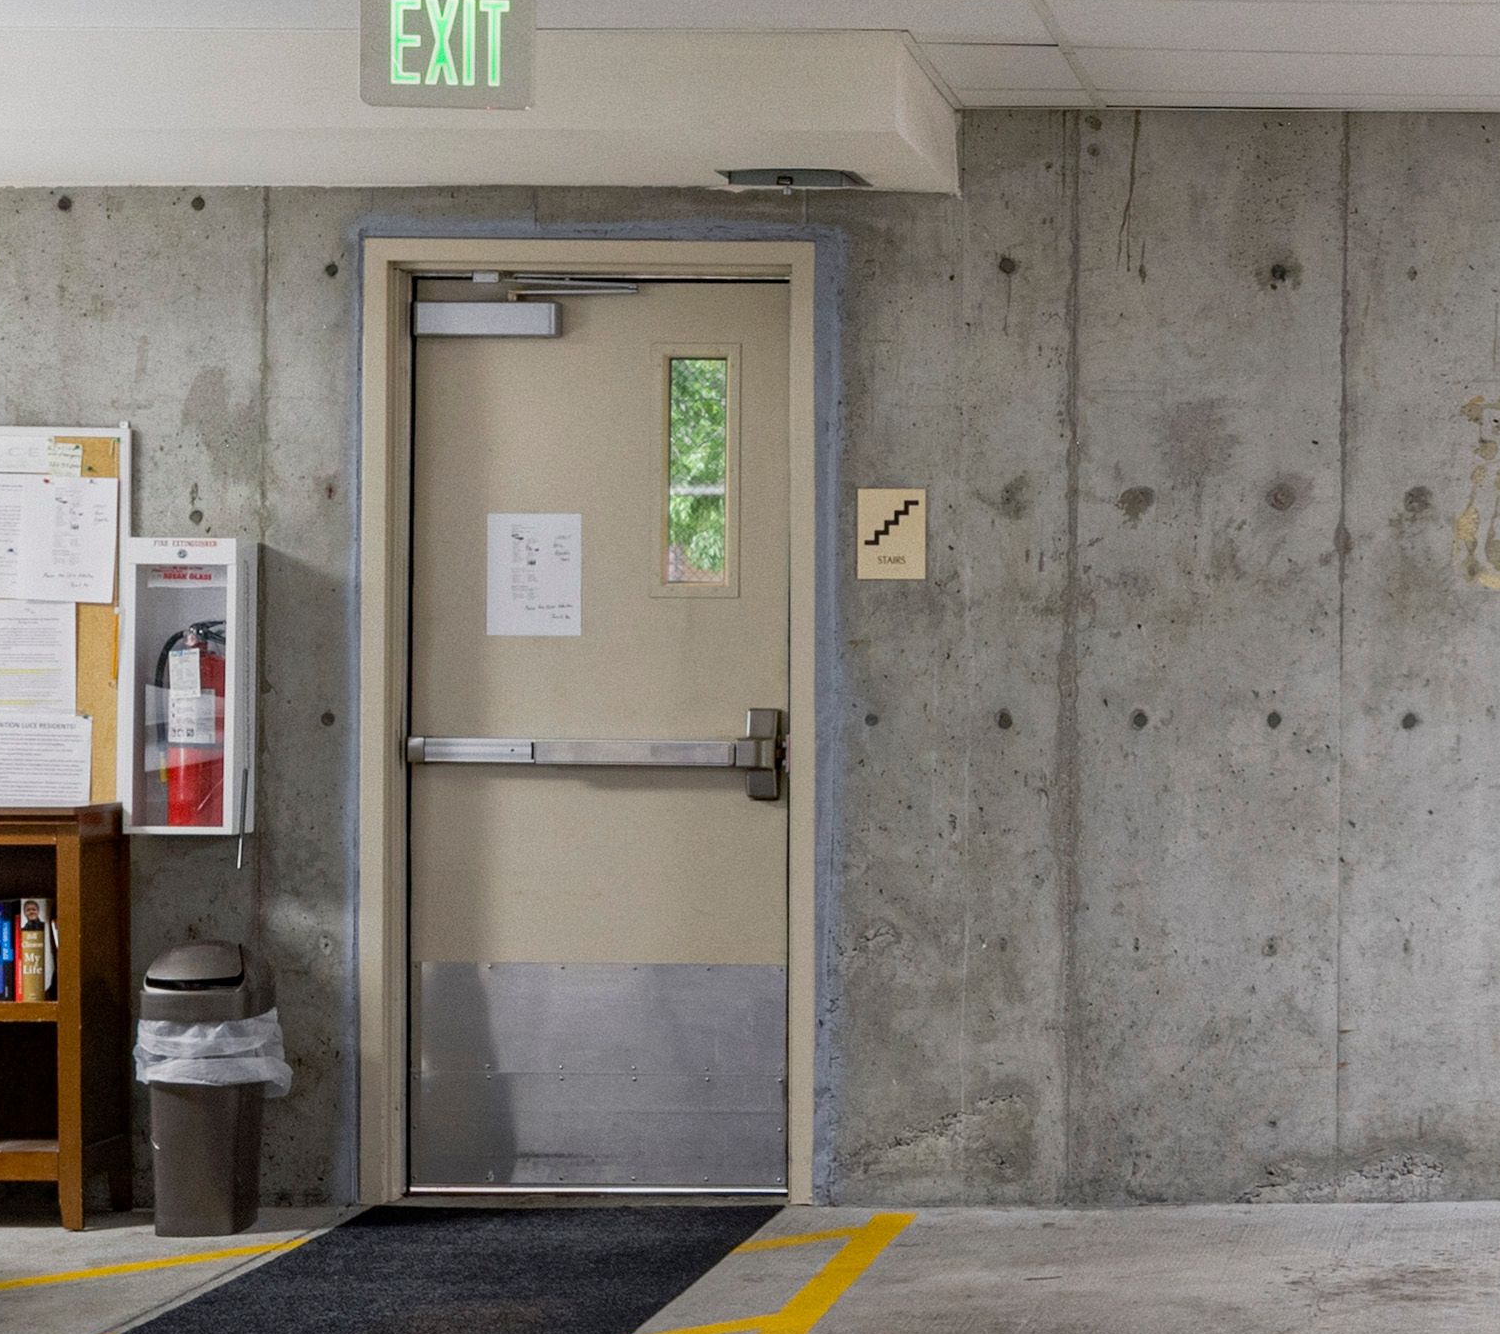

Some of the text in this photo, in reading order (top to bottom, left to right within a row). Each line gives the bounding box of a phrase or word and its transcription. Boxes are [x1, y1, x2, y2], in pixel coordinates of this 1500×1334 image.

[877, 555, 907, 564] STAIRS
[189, 573, 213, 581] GLASS
[24, 953, 41, 966] My
[23, 964, 43, 975] Life
